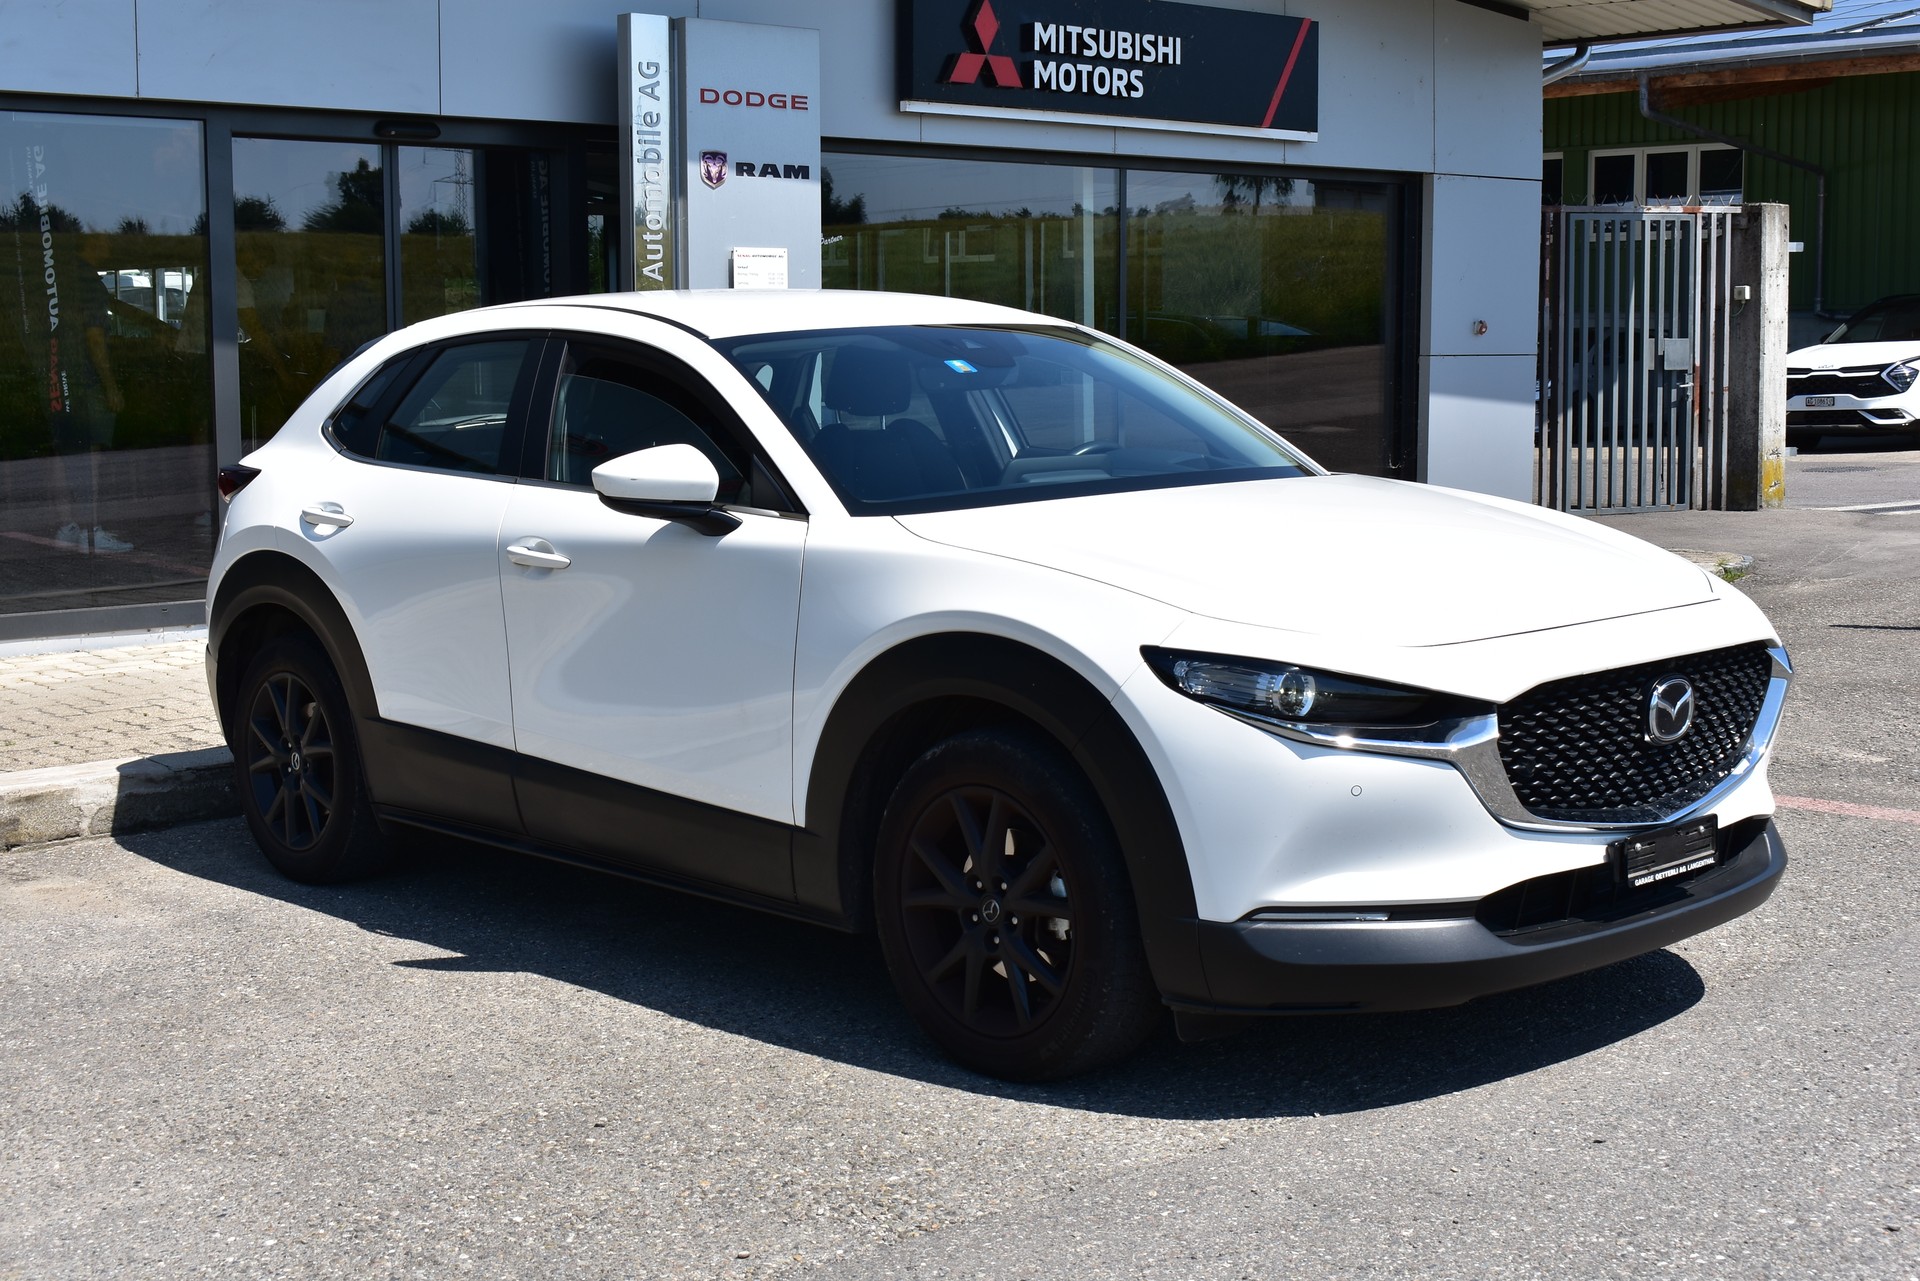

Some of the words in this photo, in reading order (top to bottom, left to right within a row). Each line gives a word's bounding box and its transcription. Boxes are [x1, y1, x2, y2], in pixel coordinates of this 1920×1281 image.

[1033, 21, 1182, 65] MITSUBISHI
[638, 61, 661, 101] AG
[1033, 60, 1144, 98] MOTORS
[700, 88, 809, 111] DODGE
[735, 162, 810, 180] RAM
[637, 111, 664, 282] Automobile
[1635, 875, 1654, 886] GARAGE
[1687, 857, 1715, 870] LANGENTHAL
